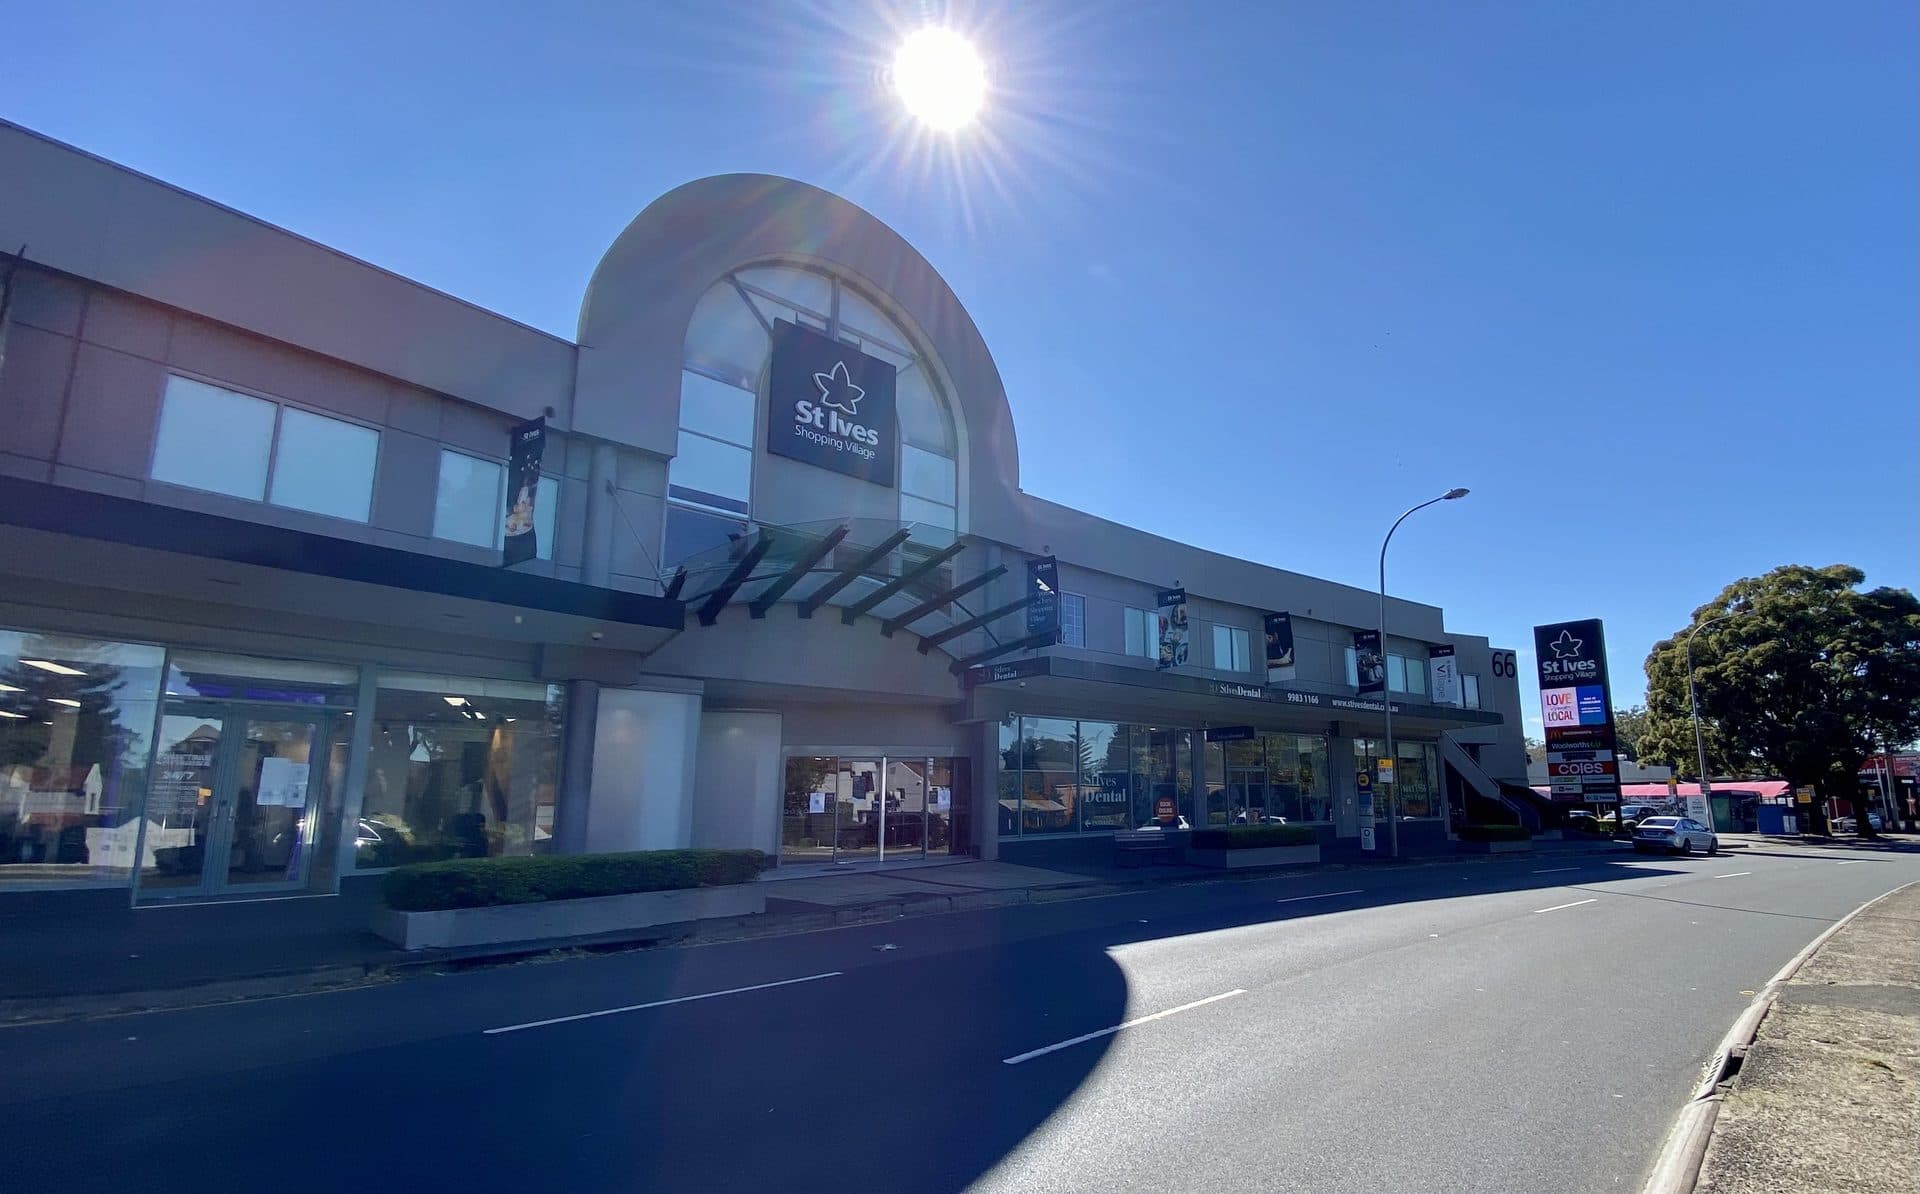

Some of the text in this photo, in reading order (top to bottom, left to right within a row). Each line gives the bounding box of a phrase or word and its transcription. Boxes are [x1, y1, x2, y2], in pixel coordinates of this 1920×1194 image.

[795, 400, 879, 446] St Ives
[795, 424, 876, 460] Shopping Village
[1492, 652, 1515, 678] 66
[1542, 659, 1597, 674] St Ives
[994, 669, 1017, 681] Dental
[1544, 670, 1597, 682] Shopping Village
[1287, 692, 1319, 705] 9983 1166
[1546, 692, 1572, 706] LOVE
[1332, 699, 1399, 713] www.stivesdental.co.au
[1548, 710, 1574, 722] LOCAL
[1558, 762, 1604, 775] coles
[1085, 787, 1126, 803] Dental
